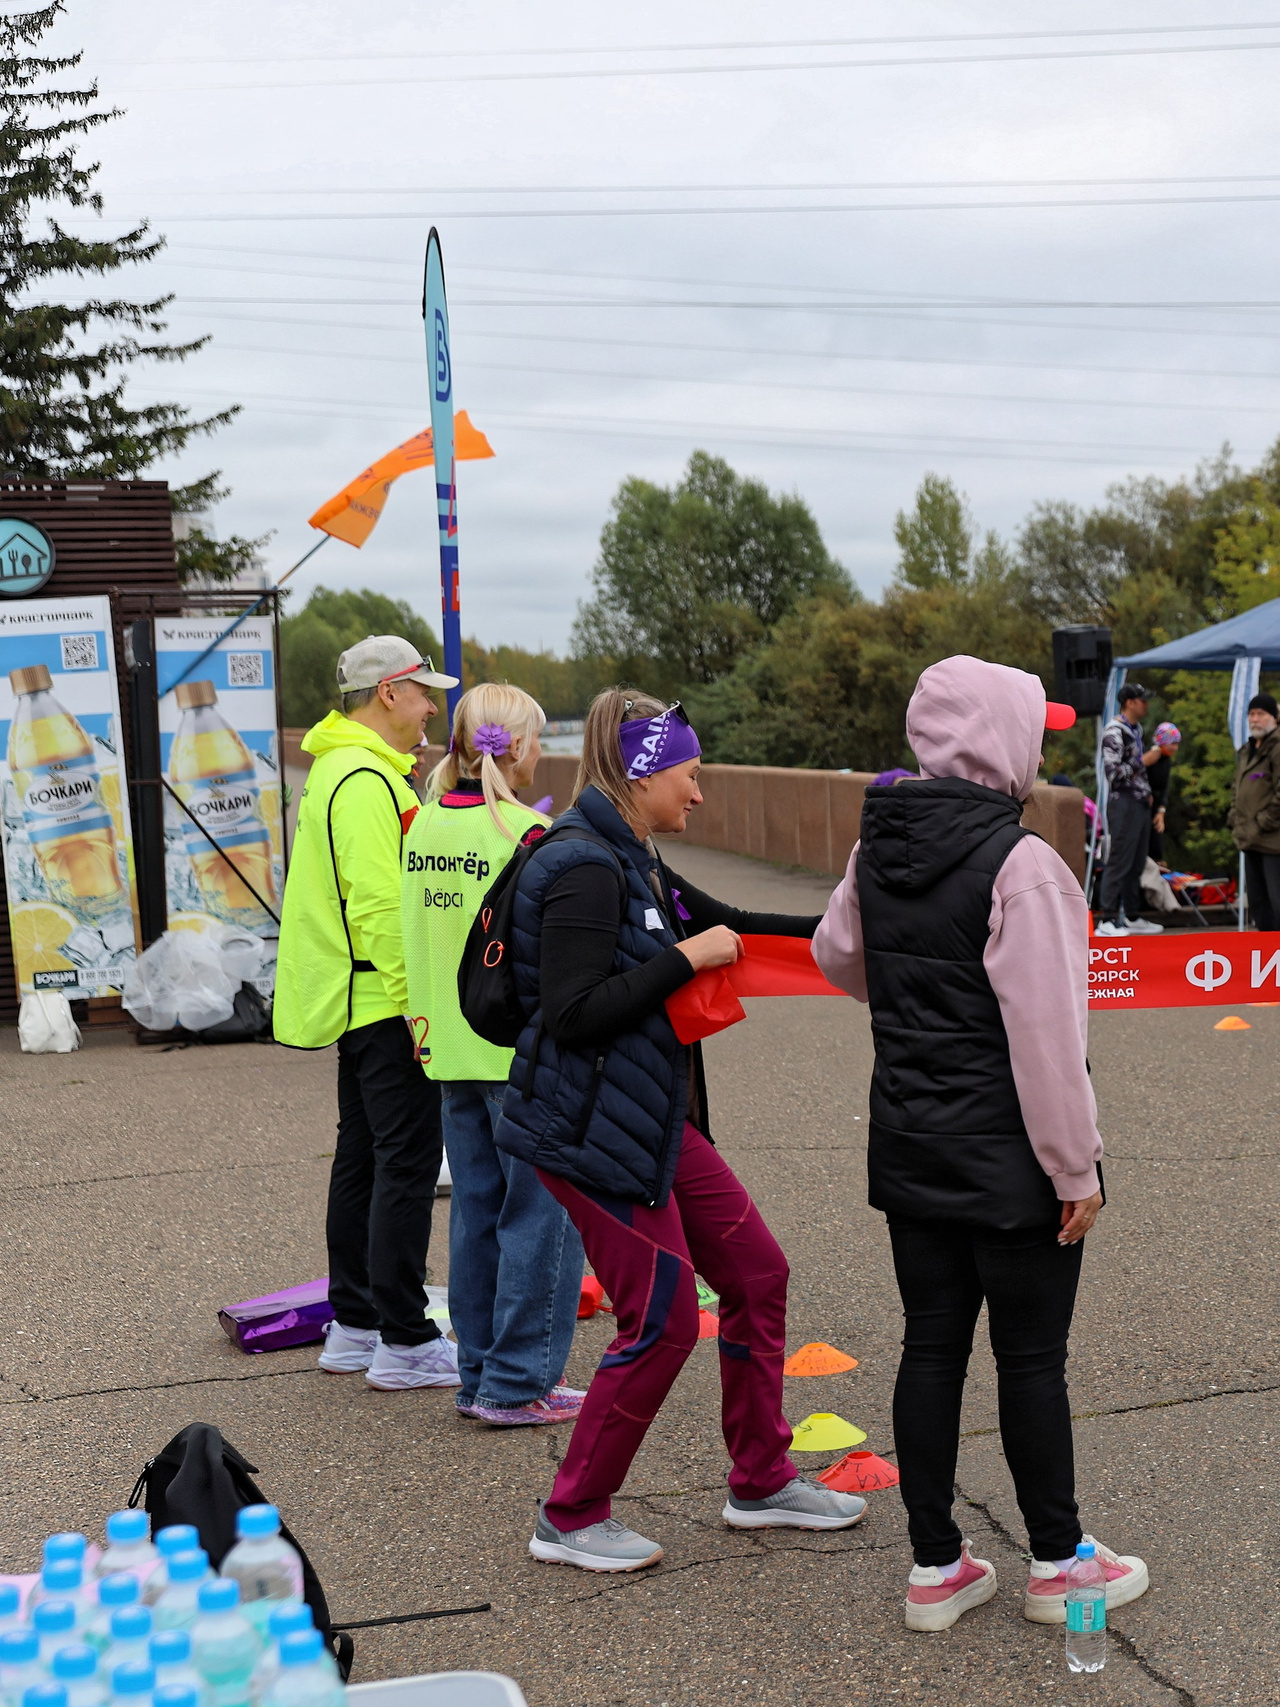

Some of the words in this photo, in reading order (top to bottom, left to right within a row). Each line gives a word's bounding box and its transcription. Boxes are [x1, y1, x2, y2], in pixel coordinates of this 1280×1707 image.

[29, 780, 93, 806] БОЧКАРИ
[407, 851, 490, 881] Волонтёр
[1088, 947, 1132, 965] РСТ
